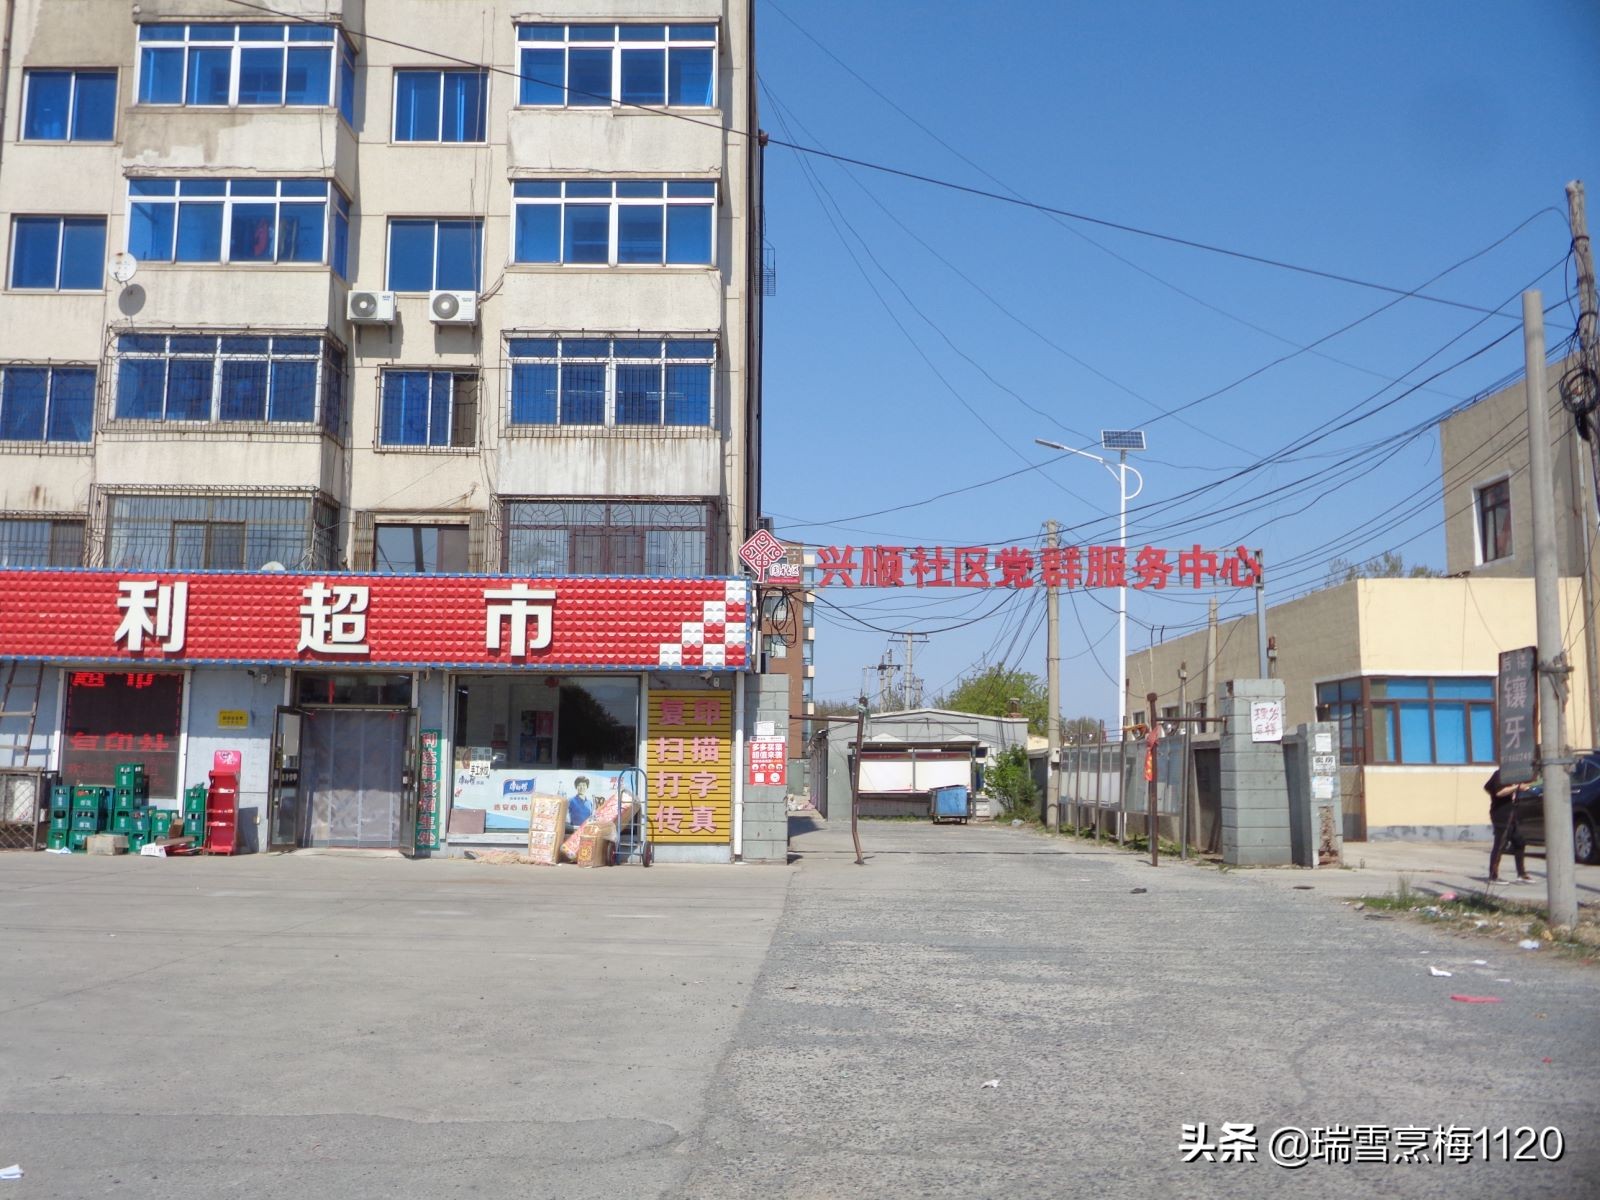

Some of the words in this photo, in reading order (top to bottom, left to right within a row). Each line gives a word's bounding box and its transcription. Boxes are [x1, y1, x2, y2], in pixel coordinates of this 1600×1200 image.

[816, 544, 1261, 589] 兴顺社区党群服务中心
[659, 699, 721, 727] 复印
[1503, 677, 1528, 749] 镶牙
[655, 736, 720, 763] 扫描
[655, 770, 718, 798] 打字
[654, 803, 717, 834] 传真
